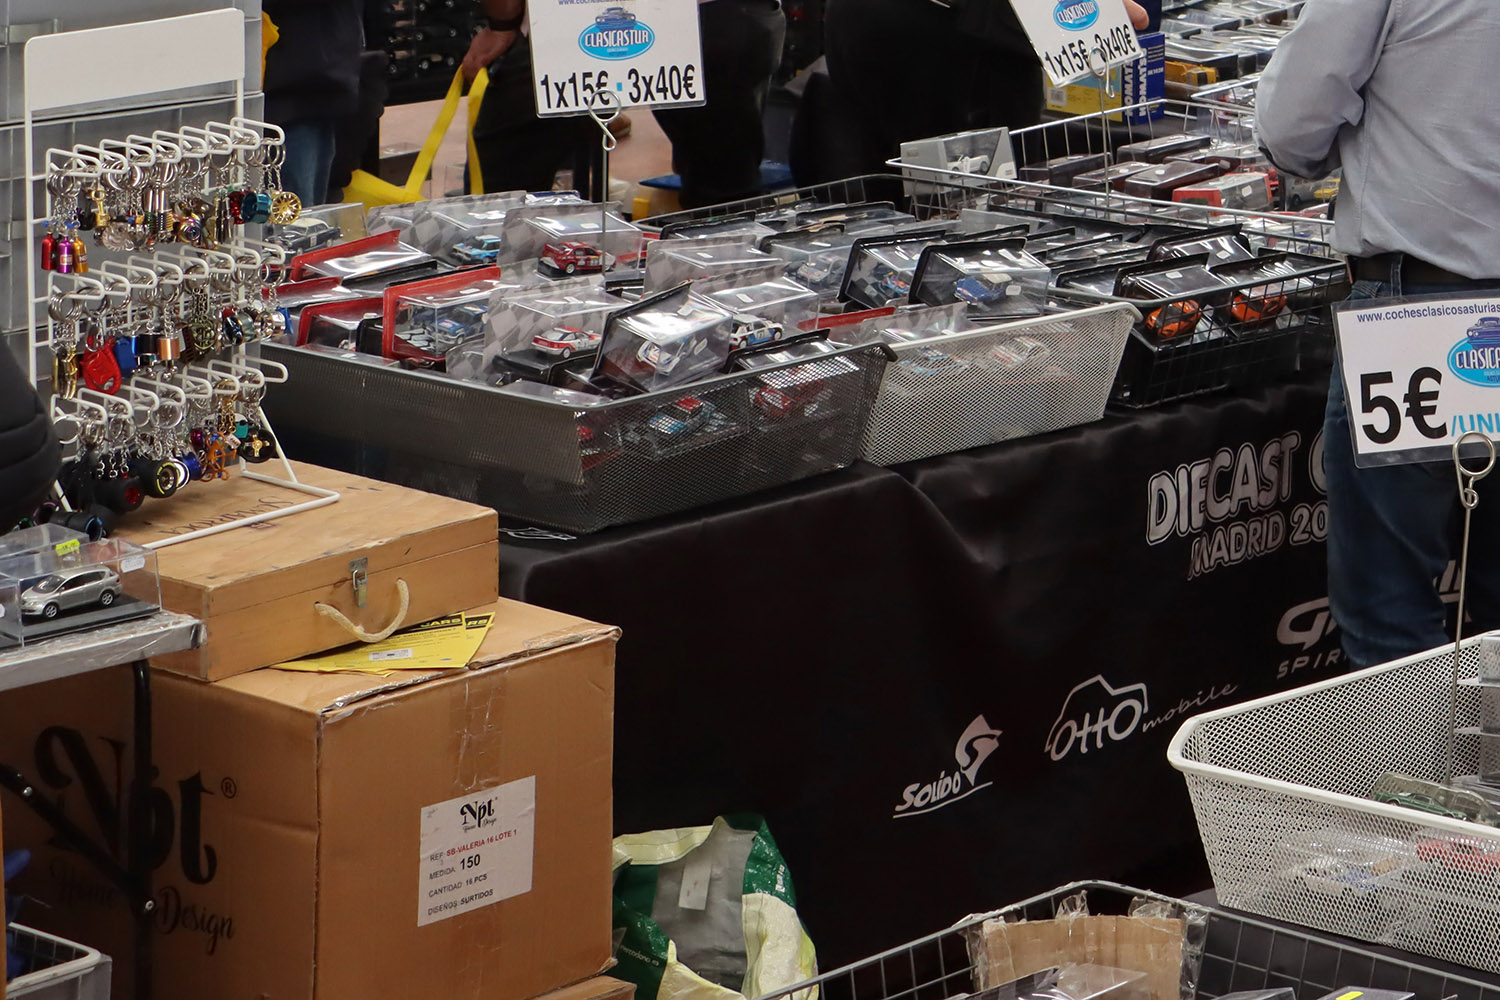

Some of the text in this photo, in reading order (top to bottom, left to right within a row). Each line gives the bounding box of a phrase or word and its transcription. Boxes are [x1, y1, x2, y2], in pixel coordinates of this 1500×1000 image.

[584, 28, 650, 49] CLASICASTUR
[540, 63, 697, 109] 1x15€ 3x40€
[1360, 366, 1449, 445] 5€
[1145, 430, 1301, 545] DIECAST
[1188, 499, 1329, 582] MADRID 20
[1276, 649, 1346, 680] SPIR
[460, 853, 481, 871] 150
[460, 889, 494, 906] SURTIDOS
